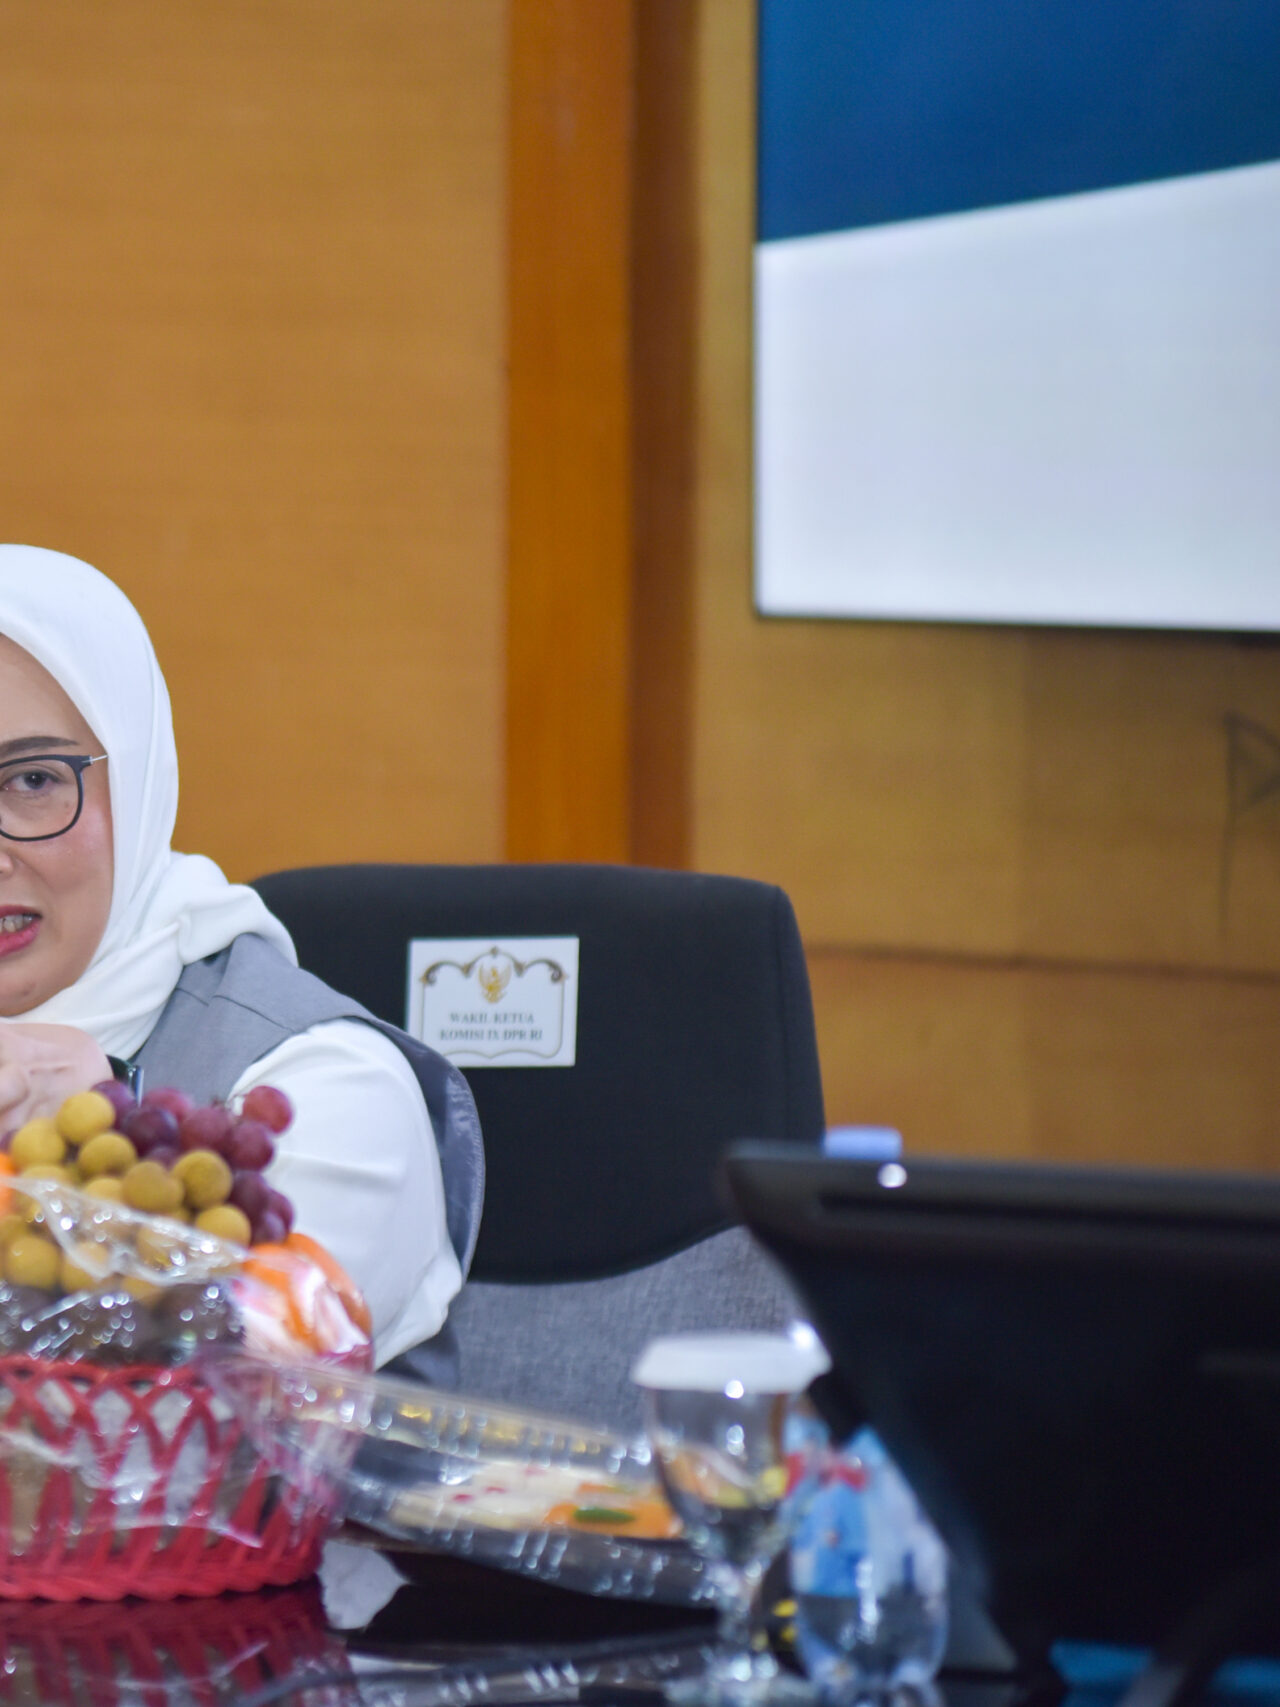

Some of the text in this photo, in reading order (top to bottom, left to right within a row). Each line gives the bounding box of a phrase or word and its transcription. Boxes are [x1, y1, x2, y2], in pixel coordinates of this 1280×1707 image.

[449, 1012, 535, 1024] WAKIL KETUA
[440, 1029, 484, 1041] KOMISI
[503, 1029, 527, 1041] DPR
[529, 1029, 543, 1041] RI
